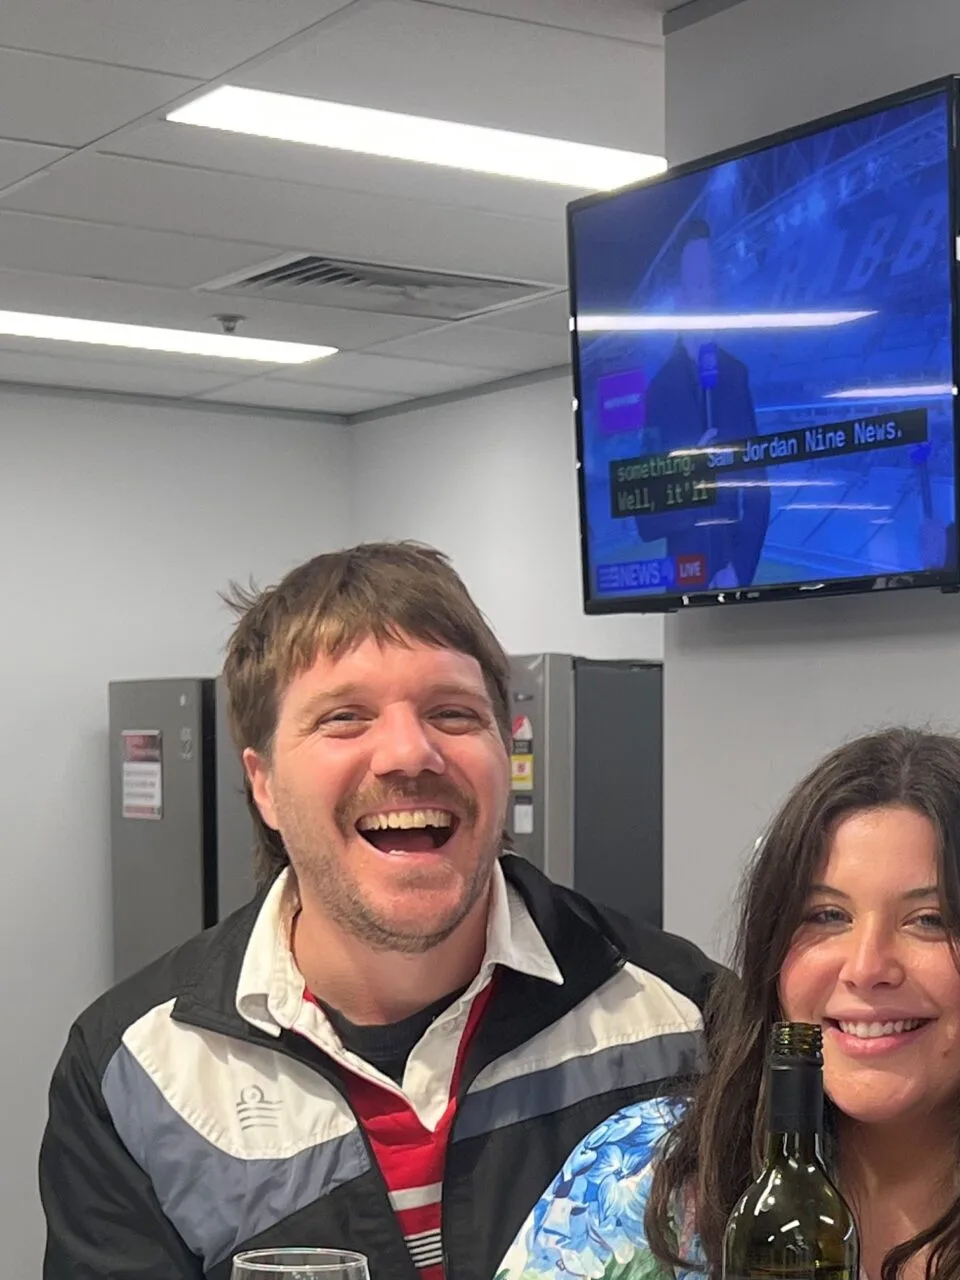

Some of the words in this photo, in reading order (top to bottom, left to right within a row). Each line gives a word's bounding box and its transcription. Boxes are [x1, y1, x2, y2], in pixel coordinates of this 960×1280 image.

[742, 435, 798, 463] Jordan
[804, 427, 846, 452] Nine
[853, 421, 902, 445] News.
[617, 486, 655, 512] Well,
[619, 561, 661, 586] NEWS
[679, 560, 701, 578] LIVE
